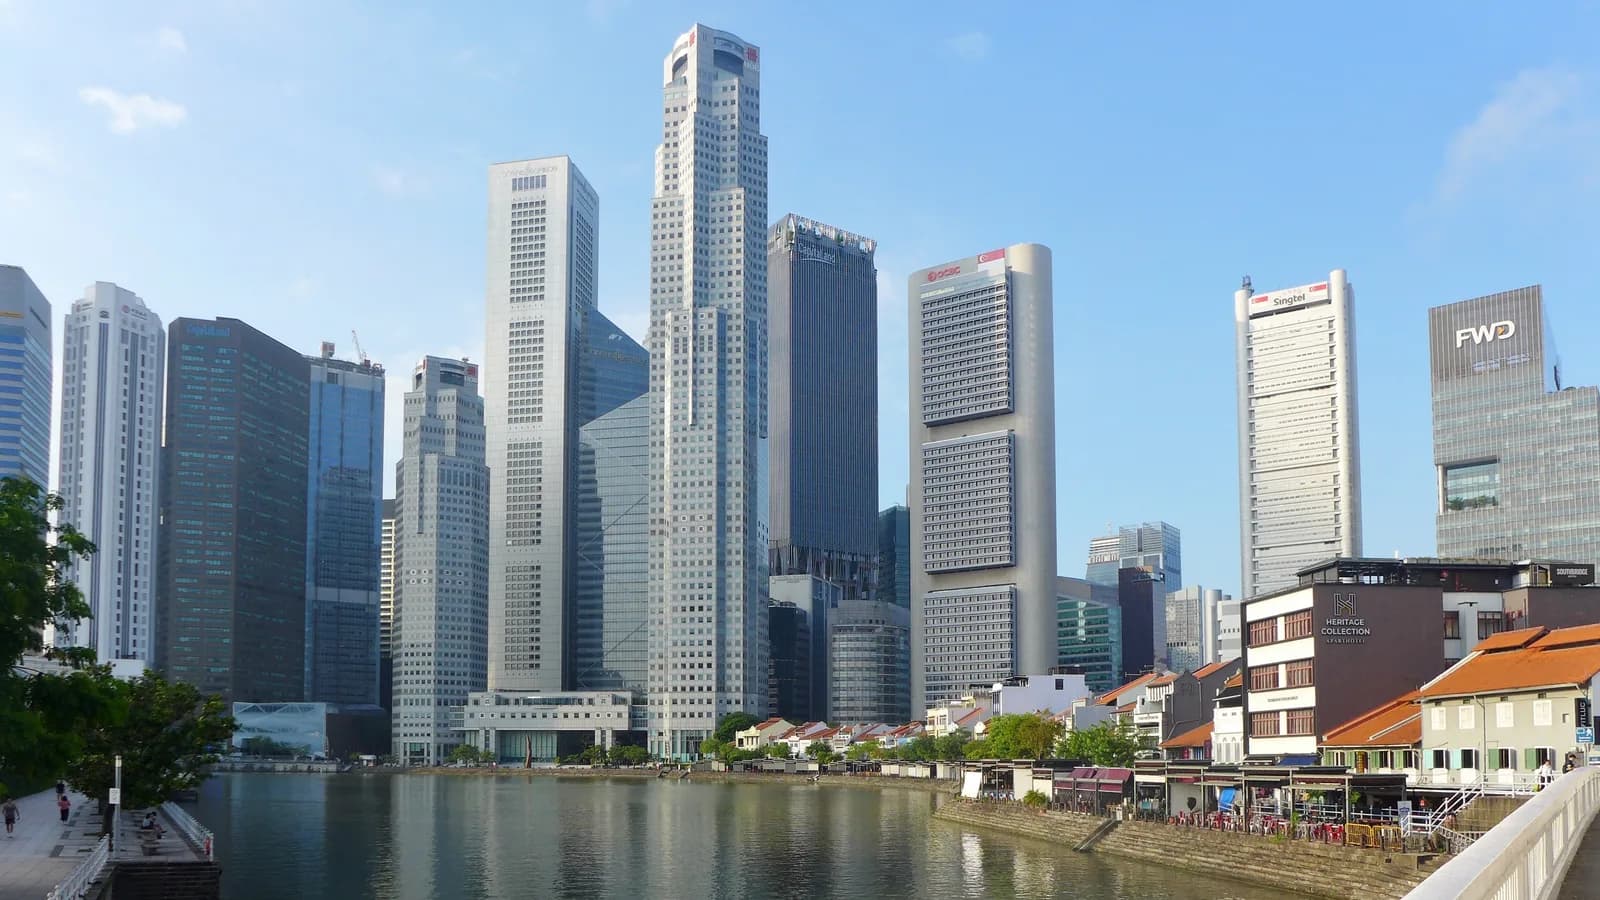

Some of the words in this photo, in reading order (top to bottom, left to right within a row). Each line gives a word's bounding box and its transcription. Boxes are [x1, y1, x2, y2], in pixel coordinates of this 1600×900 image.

[1273, 293, 1306, 306] Singtel
[1456, 320, 1516, 349] FWD
[1326, 618, 1365, 627] HERITAGE
[1320, 628, 1371, 636] COLLECTION
